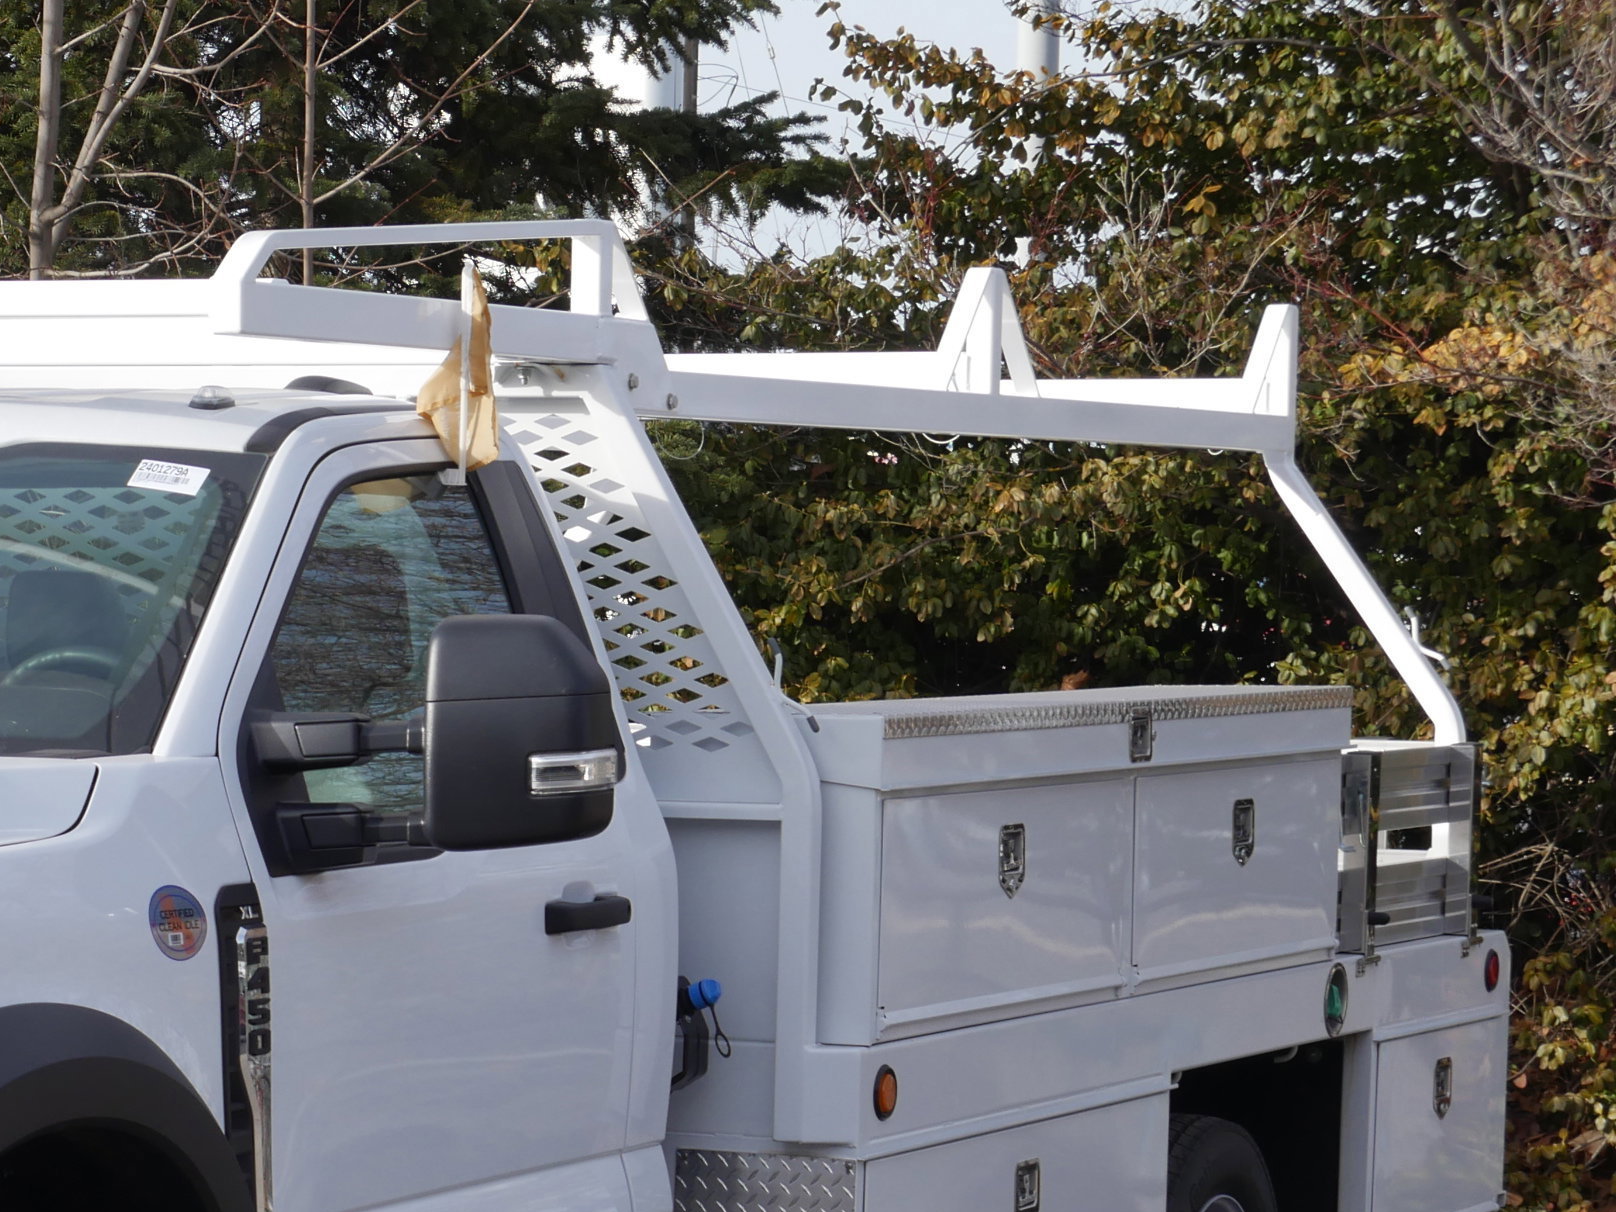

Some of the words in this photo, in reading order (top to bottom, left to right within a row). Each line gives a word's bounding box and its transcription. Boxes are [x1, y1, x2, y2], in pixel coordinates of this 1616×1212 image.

[139, 461, 189, 478] 2401279A
[159, 908, 195, 919] CERTIFIED
[240, 905, 259, 920] XL
[158, 921, 183, 932] CLEAN
